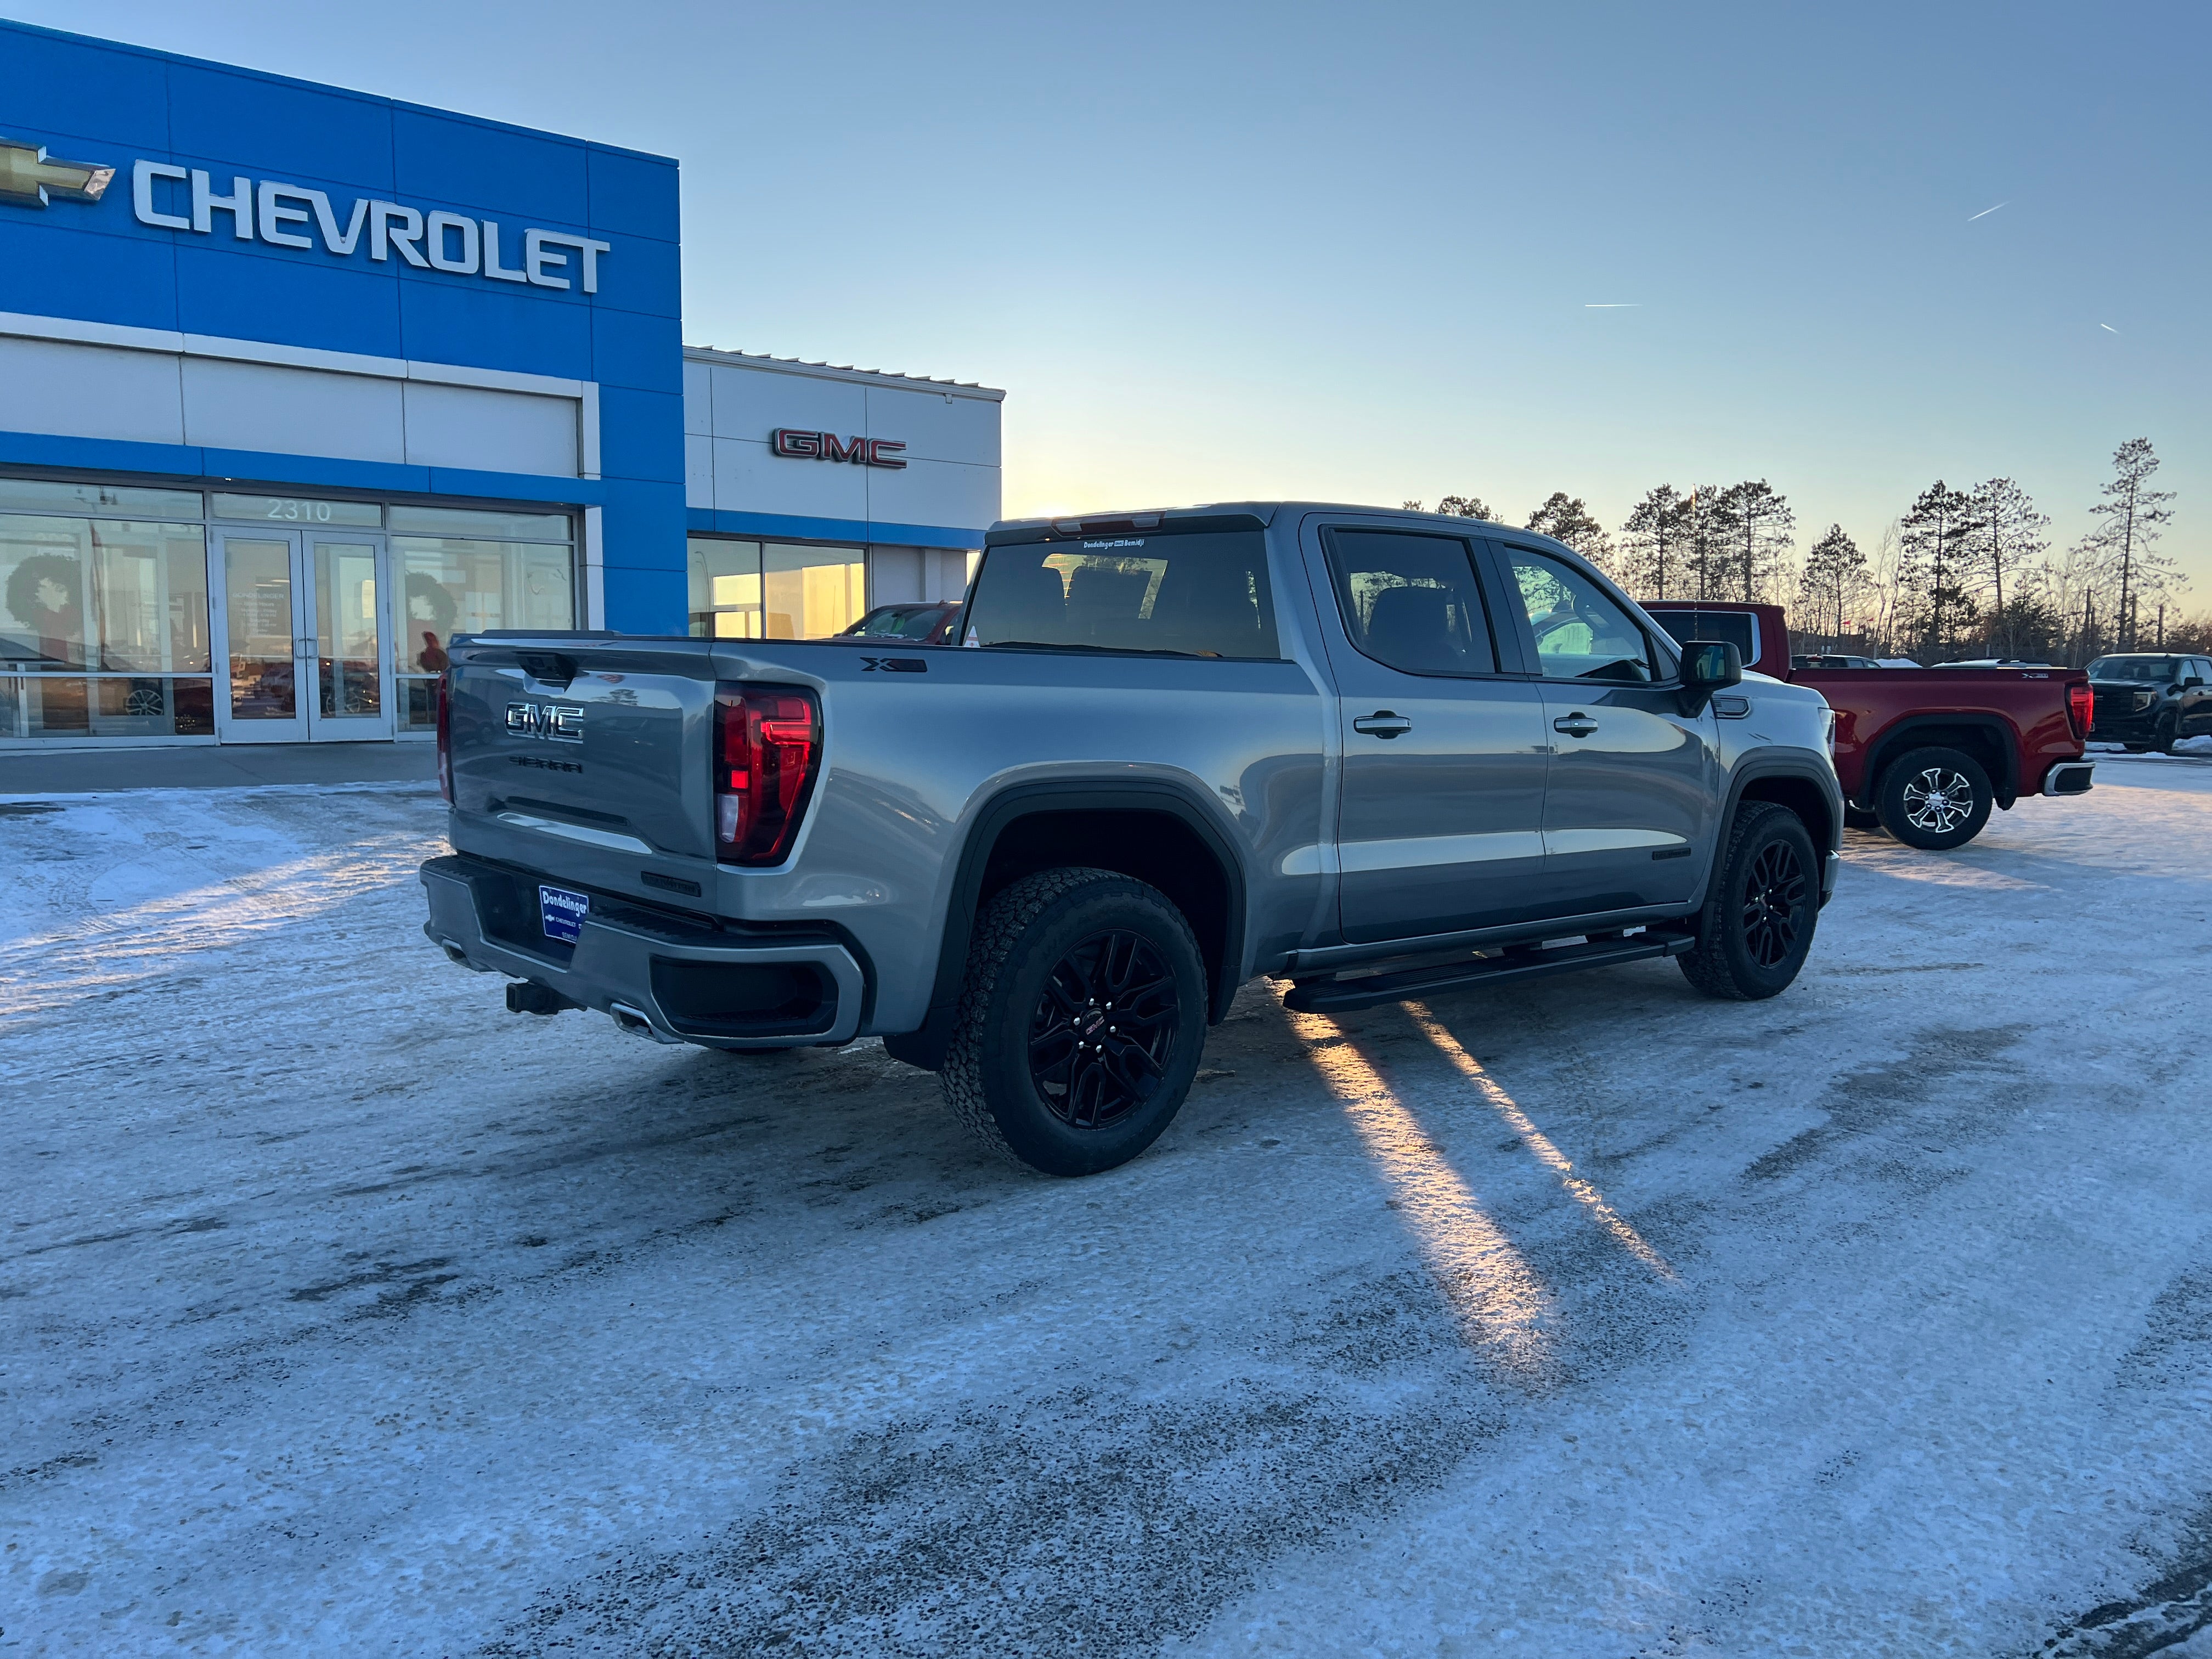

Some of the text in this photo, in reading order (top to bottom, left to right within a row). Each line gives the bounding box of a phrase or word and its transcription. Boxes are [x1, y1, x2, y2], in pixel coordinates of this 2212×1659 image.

[133, 159, 611, 294] CHEVROLET
[772, 428, 907, 469] GMC
[268, 499, 331, 521] 2310
[1084, 541, 1114, 550] Dondelinger
[505, 702, 584, 744] GMC
[509, 757, 583, 774] SIERRA
[543, 891, 587, 917] Dondelinger
[1086, 1016, 1104, 1035] GMC
